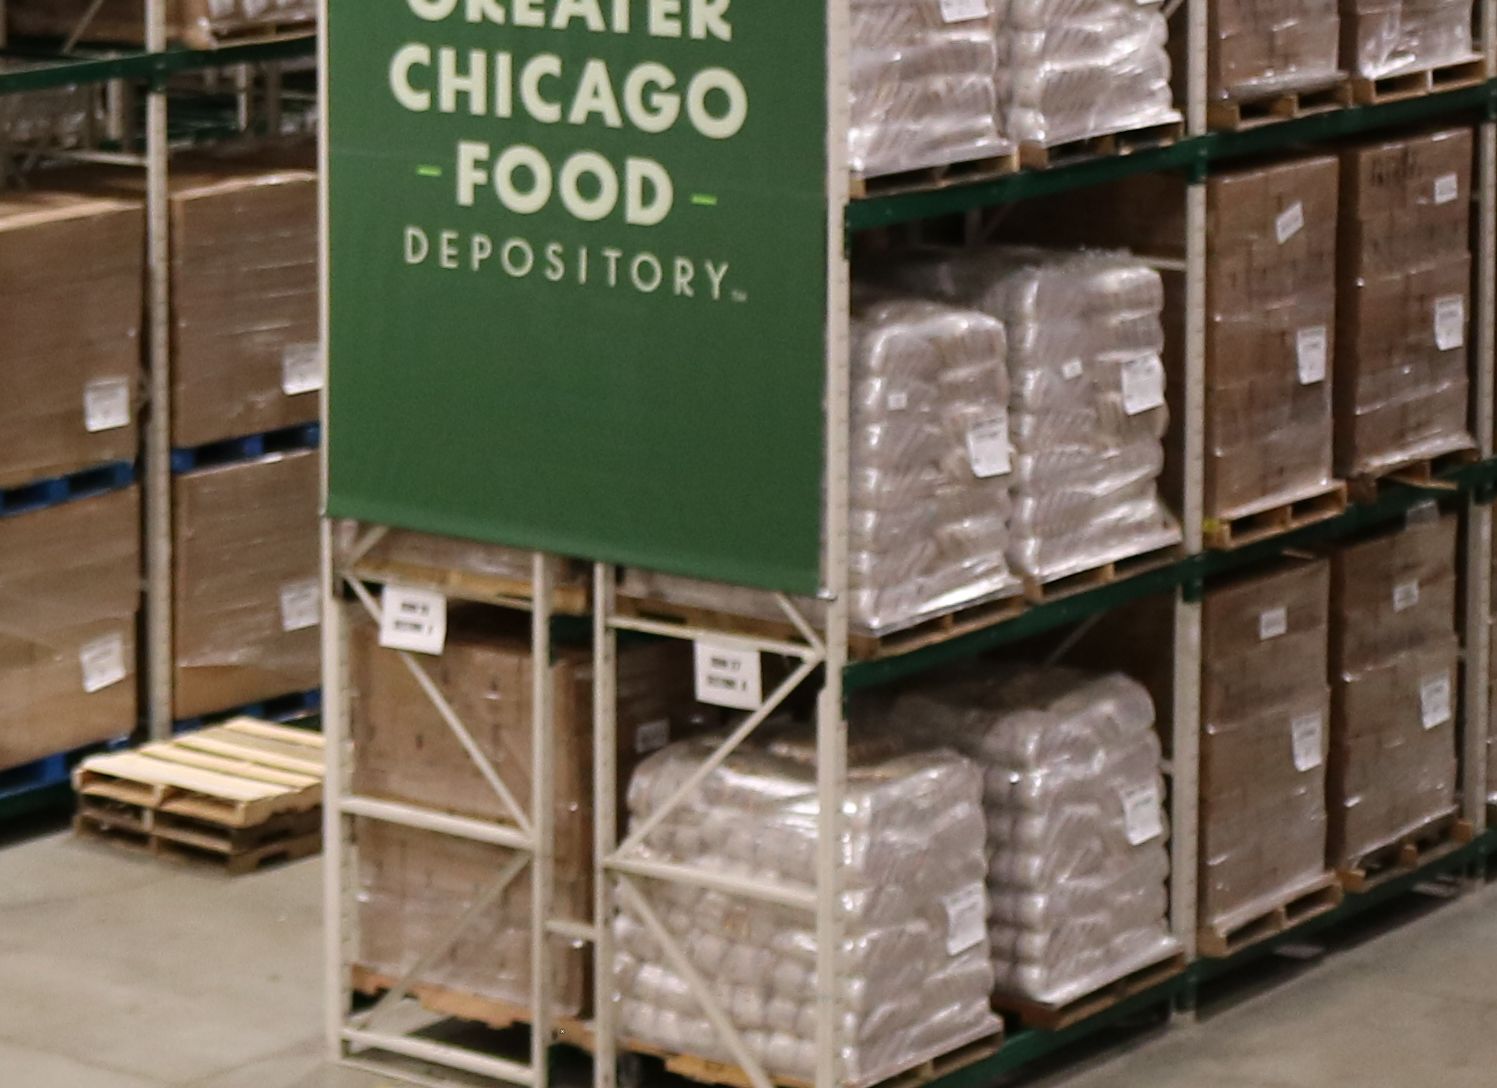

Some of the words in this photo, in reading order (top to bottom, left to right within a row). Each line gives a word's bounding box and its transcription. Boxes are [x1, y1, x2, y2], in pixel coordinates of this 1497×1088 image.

[388, 42, 748, 139] CHICAGO
[456, 140, 674, 227] FOOD
[405, 225, 730, 302] DEPOSITORY
